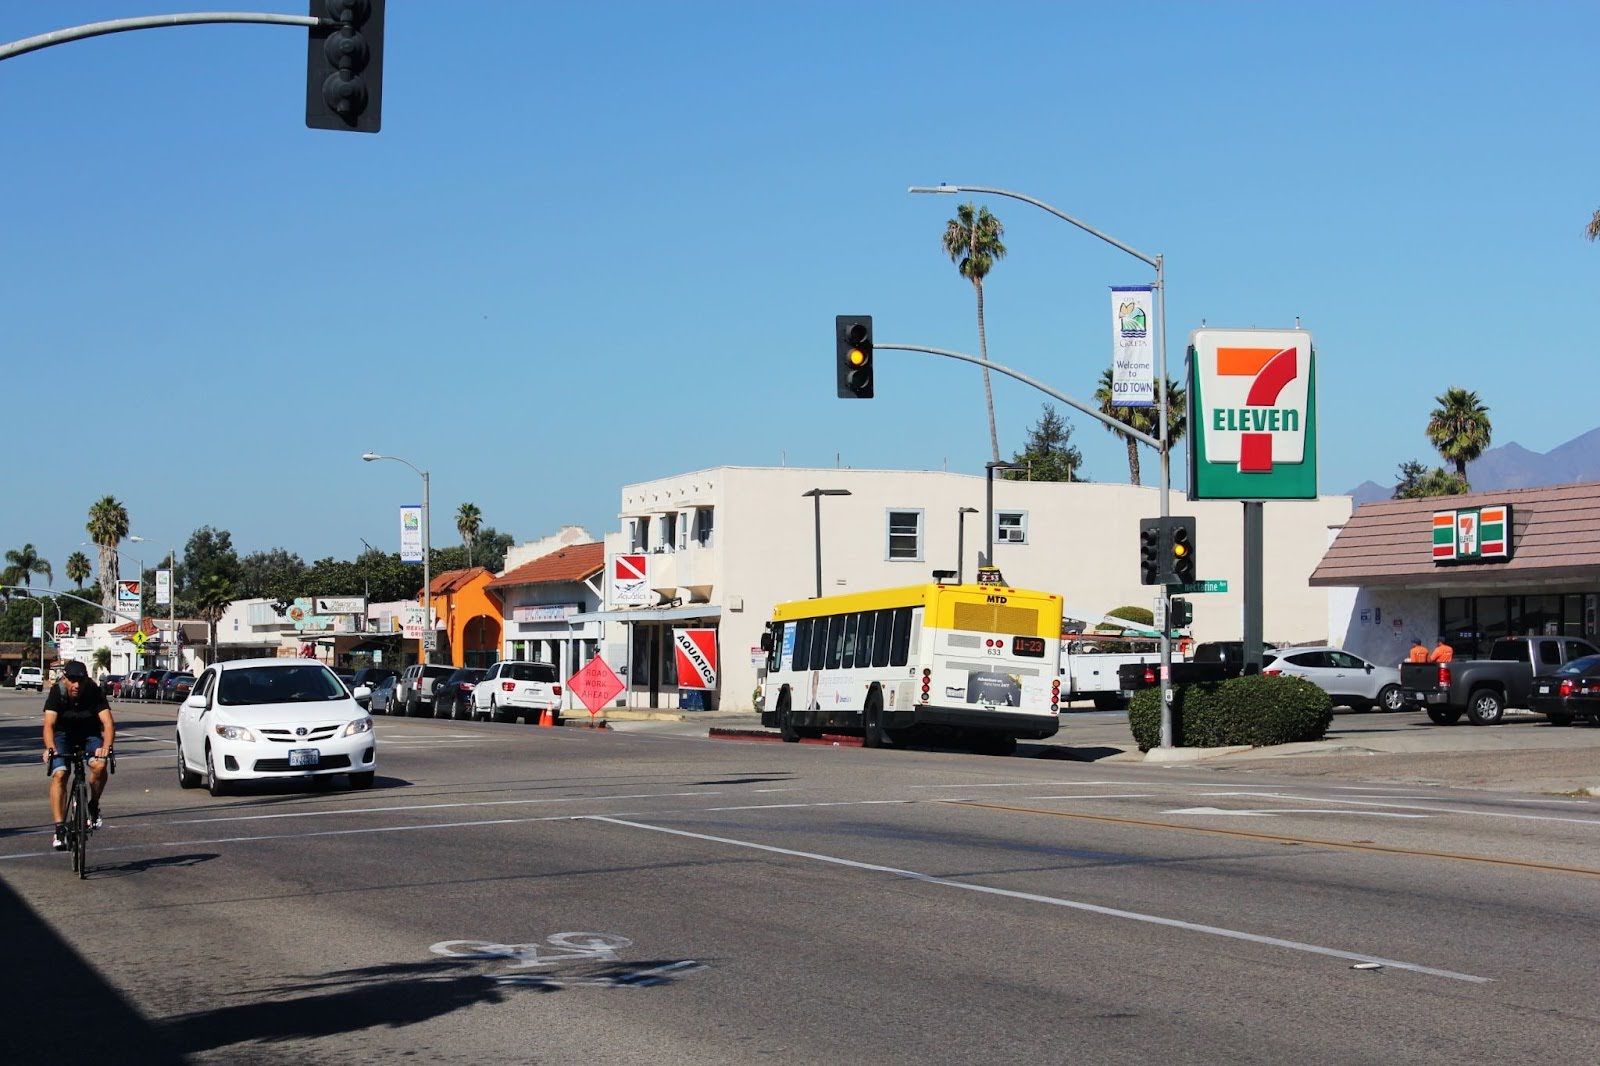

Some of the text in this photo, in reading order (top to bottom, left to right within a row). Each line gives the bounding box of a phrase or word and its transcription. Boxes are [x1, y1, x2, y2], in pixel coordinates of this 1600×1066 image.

[1116, 360, 1150, 369] Welcome
[1113, 382, 1153, 393] OLD TOWN
[1184, 581, 1218, 592] nectarine
[986, 595, 1008, 604] MTD
[424, 640, 436, 649] 25
[987, 648, 1001, 656] 633
[677, 635, 715, 684] AQUATICS
[586, 669, 608, 677] ROAD
[582, 690, 609, 699] AHEAD
